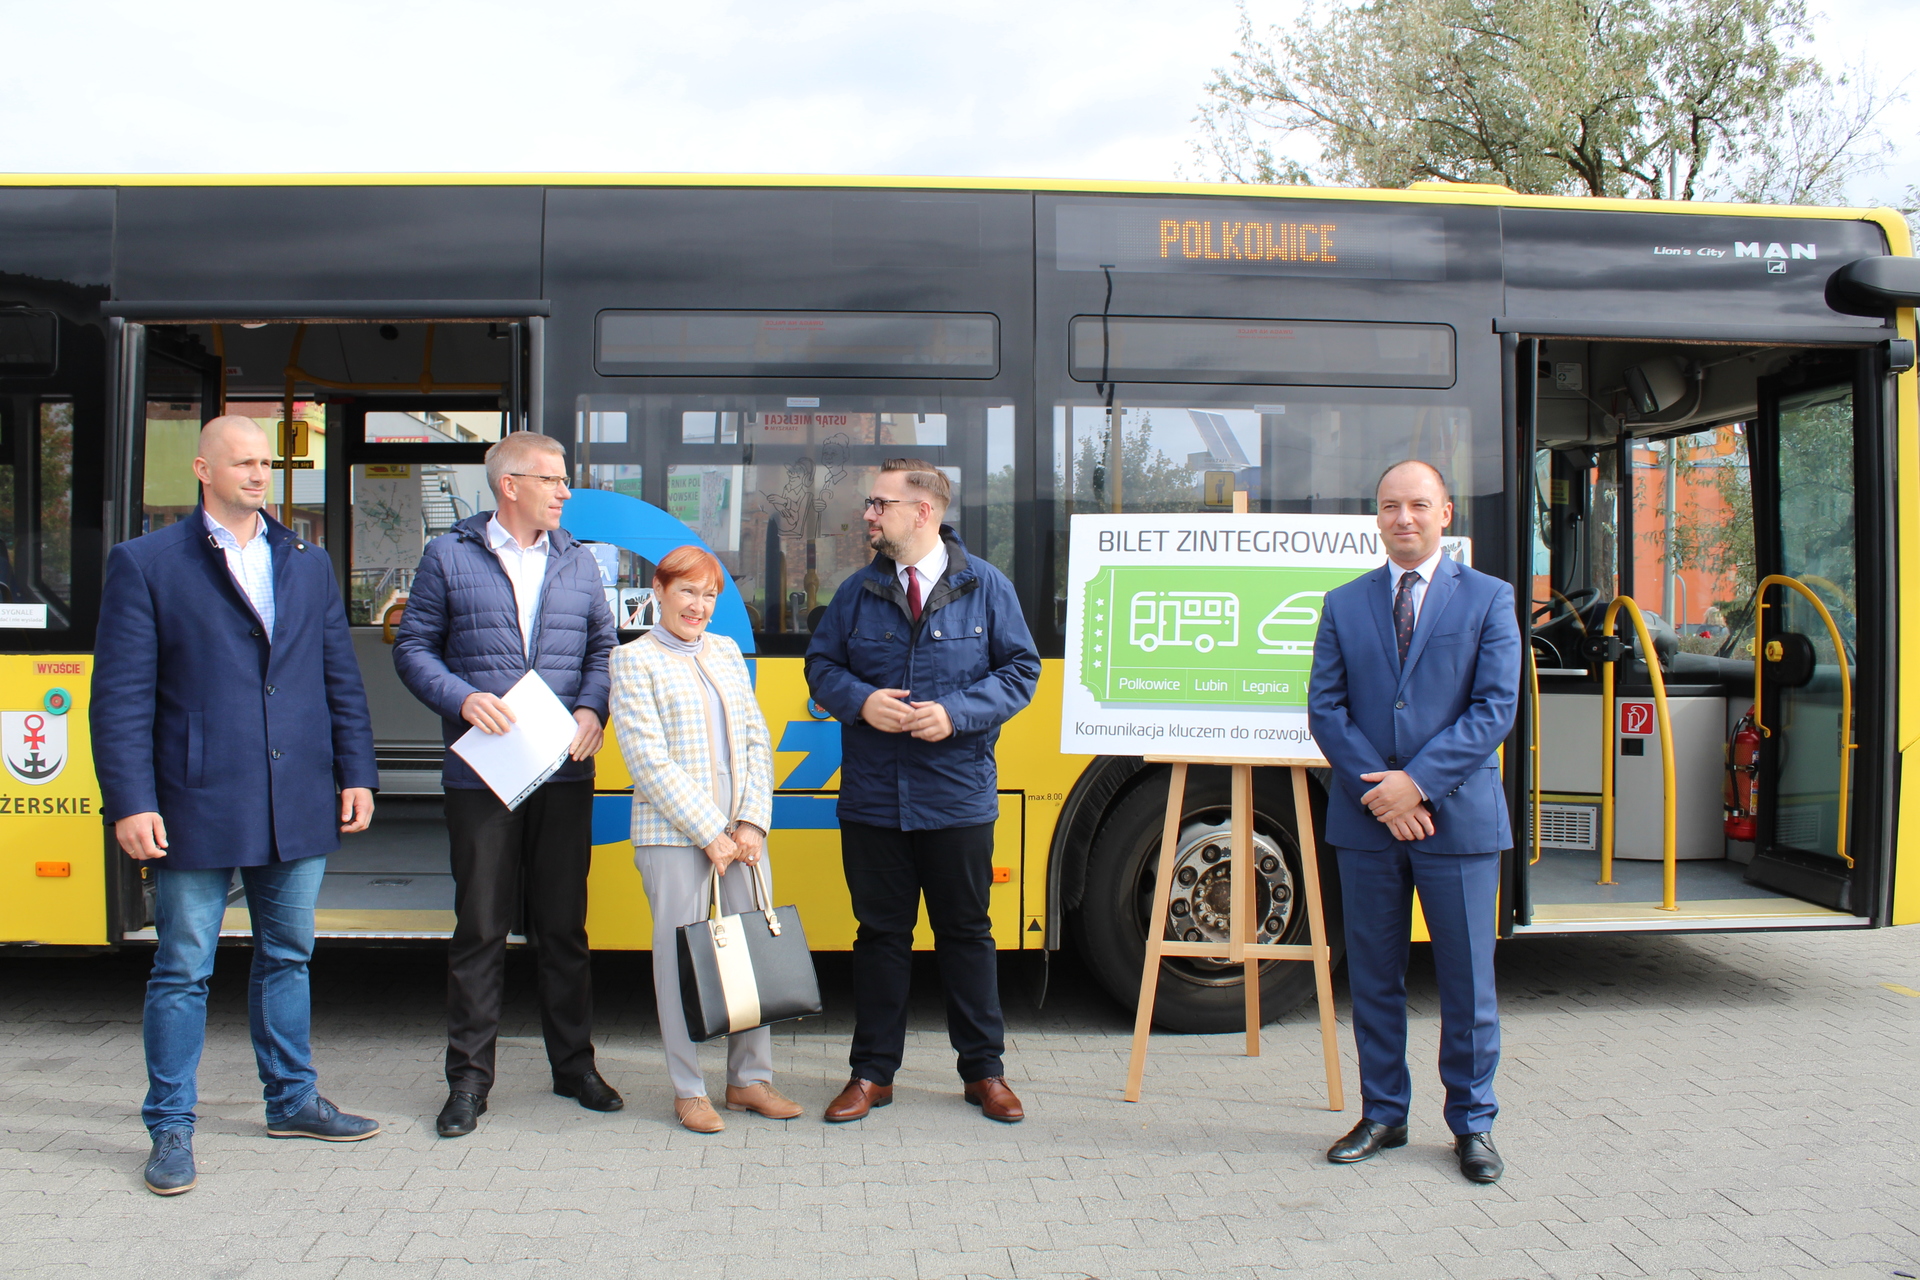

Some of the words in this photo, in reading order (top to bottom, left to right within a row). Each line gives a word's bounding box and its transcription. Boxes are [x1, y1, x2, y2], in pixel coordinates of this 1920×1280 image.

[1160, 220, 1337, 262] POLKOWICE
[1653, 246, 1691, 256] Lion's
[1696, 247, 1727, 259] City
[1734, 241, 1817, 260] MAN
[1099, 530, 1170, 552] BILET
[1176, 530, 1387, 555] ZINTEGROWAN
[37, 662, 81, 674] WYJŚCIE
[1119, 677, 1181, 691] Polkowice
[1194, 679, 1228, 692] Lubin
[1242, 680, 1290, 695] Legnica
[1075, 721, 1164, 740] Komunikacja
[1169, 723, 1226, 739] kluczem
[1230, 725, 1250, 739] do
[1253, 727, 1312, 744] rozwoju
